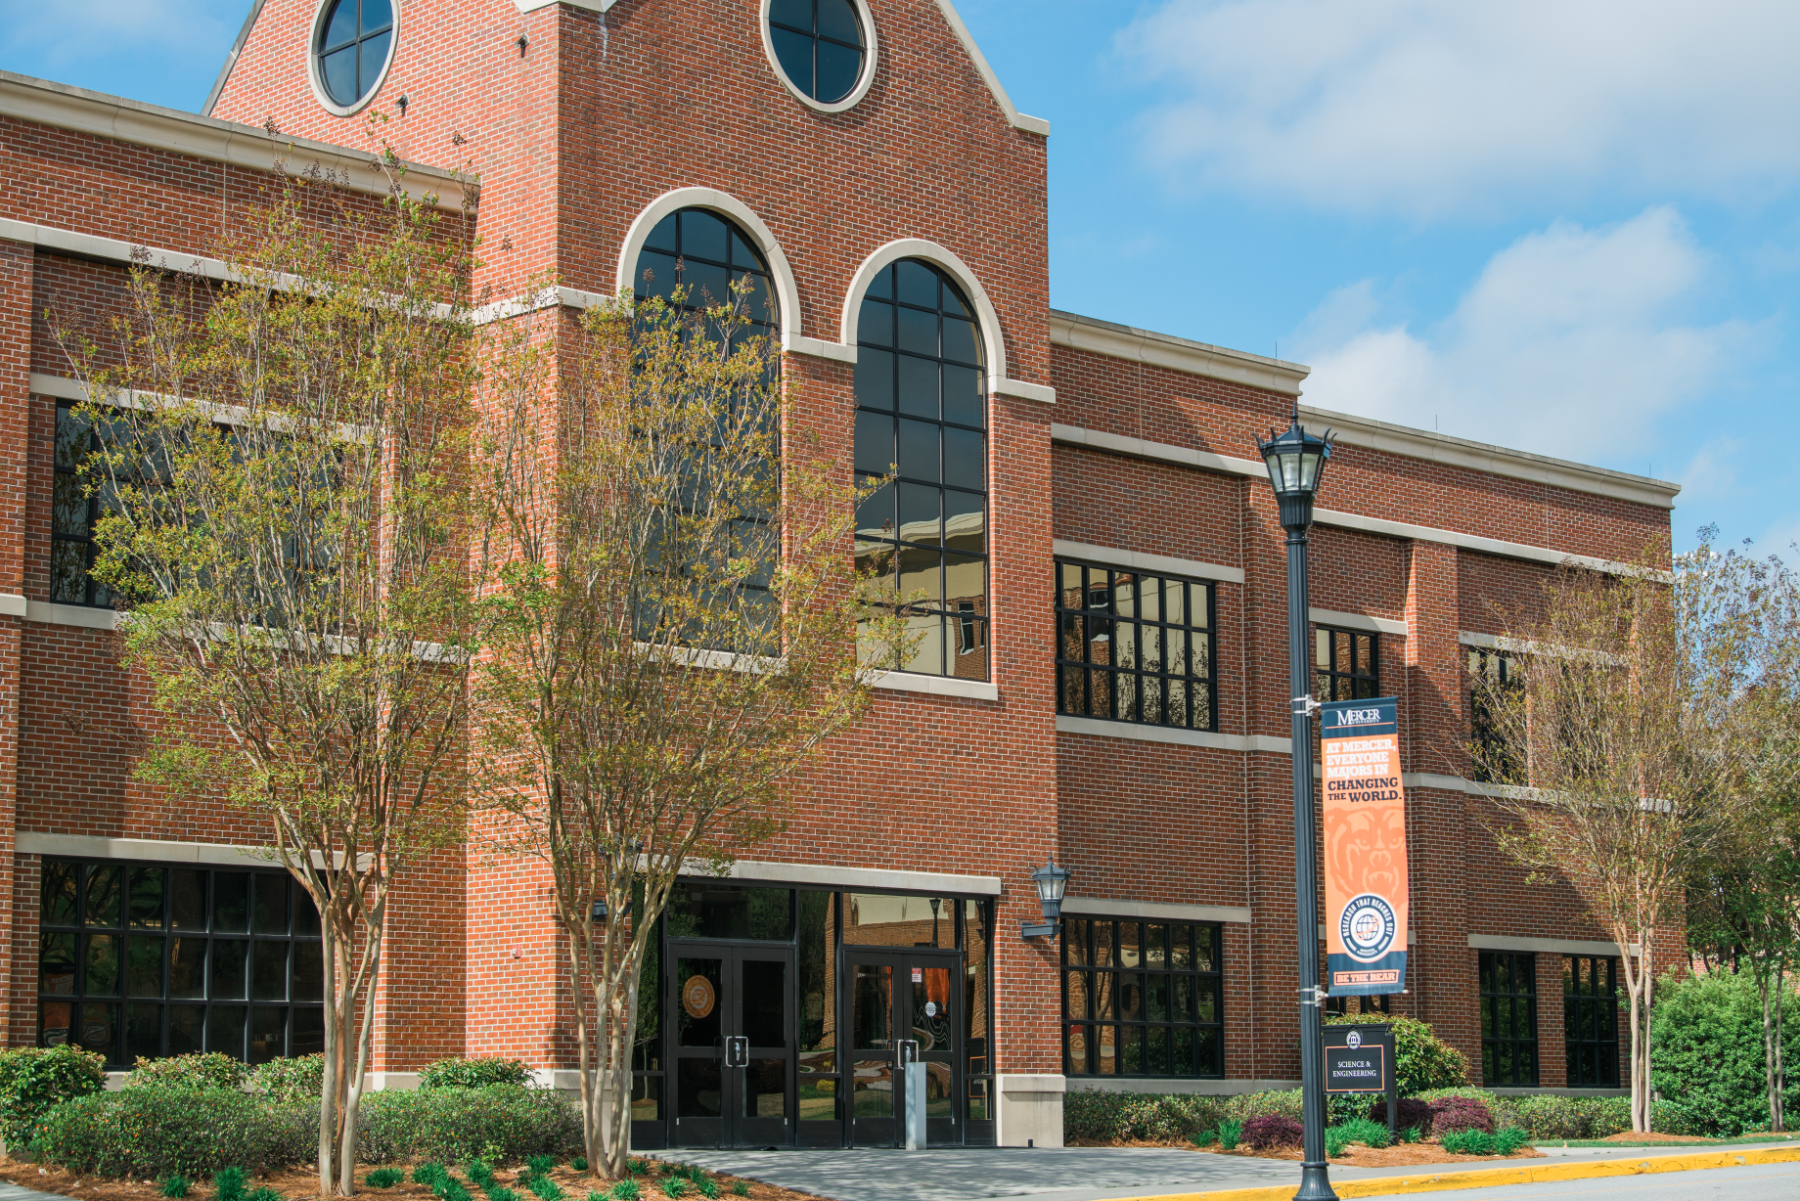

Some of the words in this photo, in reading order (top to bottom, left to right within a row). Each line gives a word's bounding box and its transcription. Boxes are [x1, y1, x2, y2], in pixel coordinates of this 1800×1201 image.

[1337, 709, 1381, 726] MERCER
[1326, 743, 1341, 753] AT
[1342, 739, 1396, 751] MERCER,
[1326, 752, 1389, 765] EVERYONE
[1326, 764, 1373, 779] MAJORS
[1374, 764, 1389, 775] IN
[1328, 777, 1398, 791] CHANGING
[1348, 790, 1402, 802] WORLD.
[1342, 903, 1357, 937] RESEARCH
[1355, 898, 1371, 908] THAT
[1371, 899, 1393, 924] REACHES
[1385, 922, 1394, 936] OUT
[1336, 974, 1350, 983] BE
[1350, 973, 1368, 982] THE
[1370, 972, 1396, 982] BEAR
